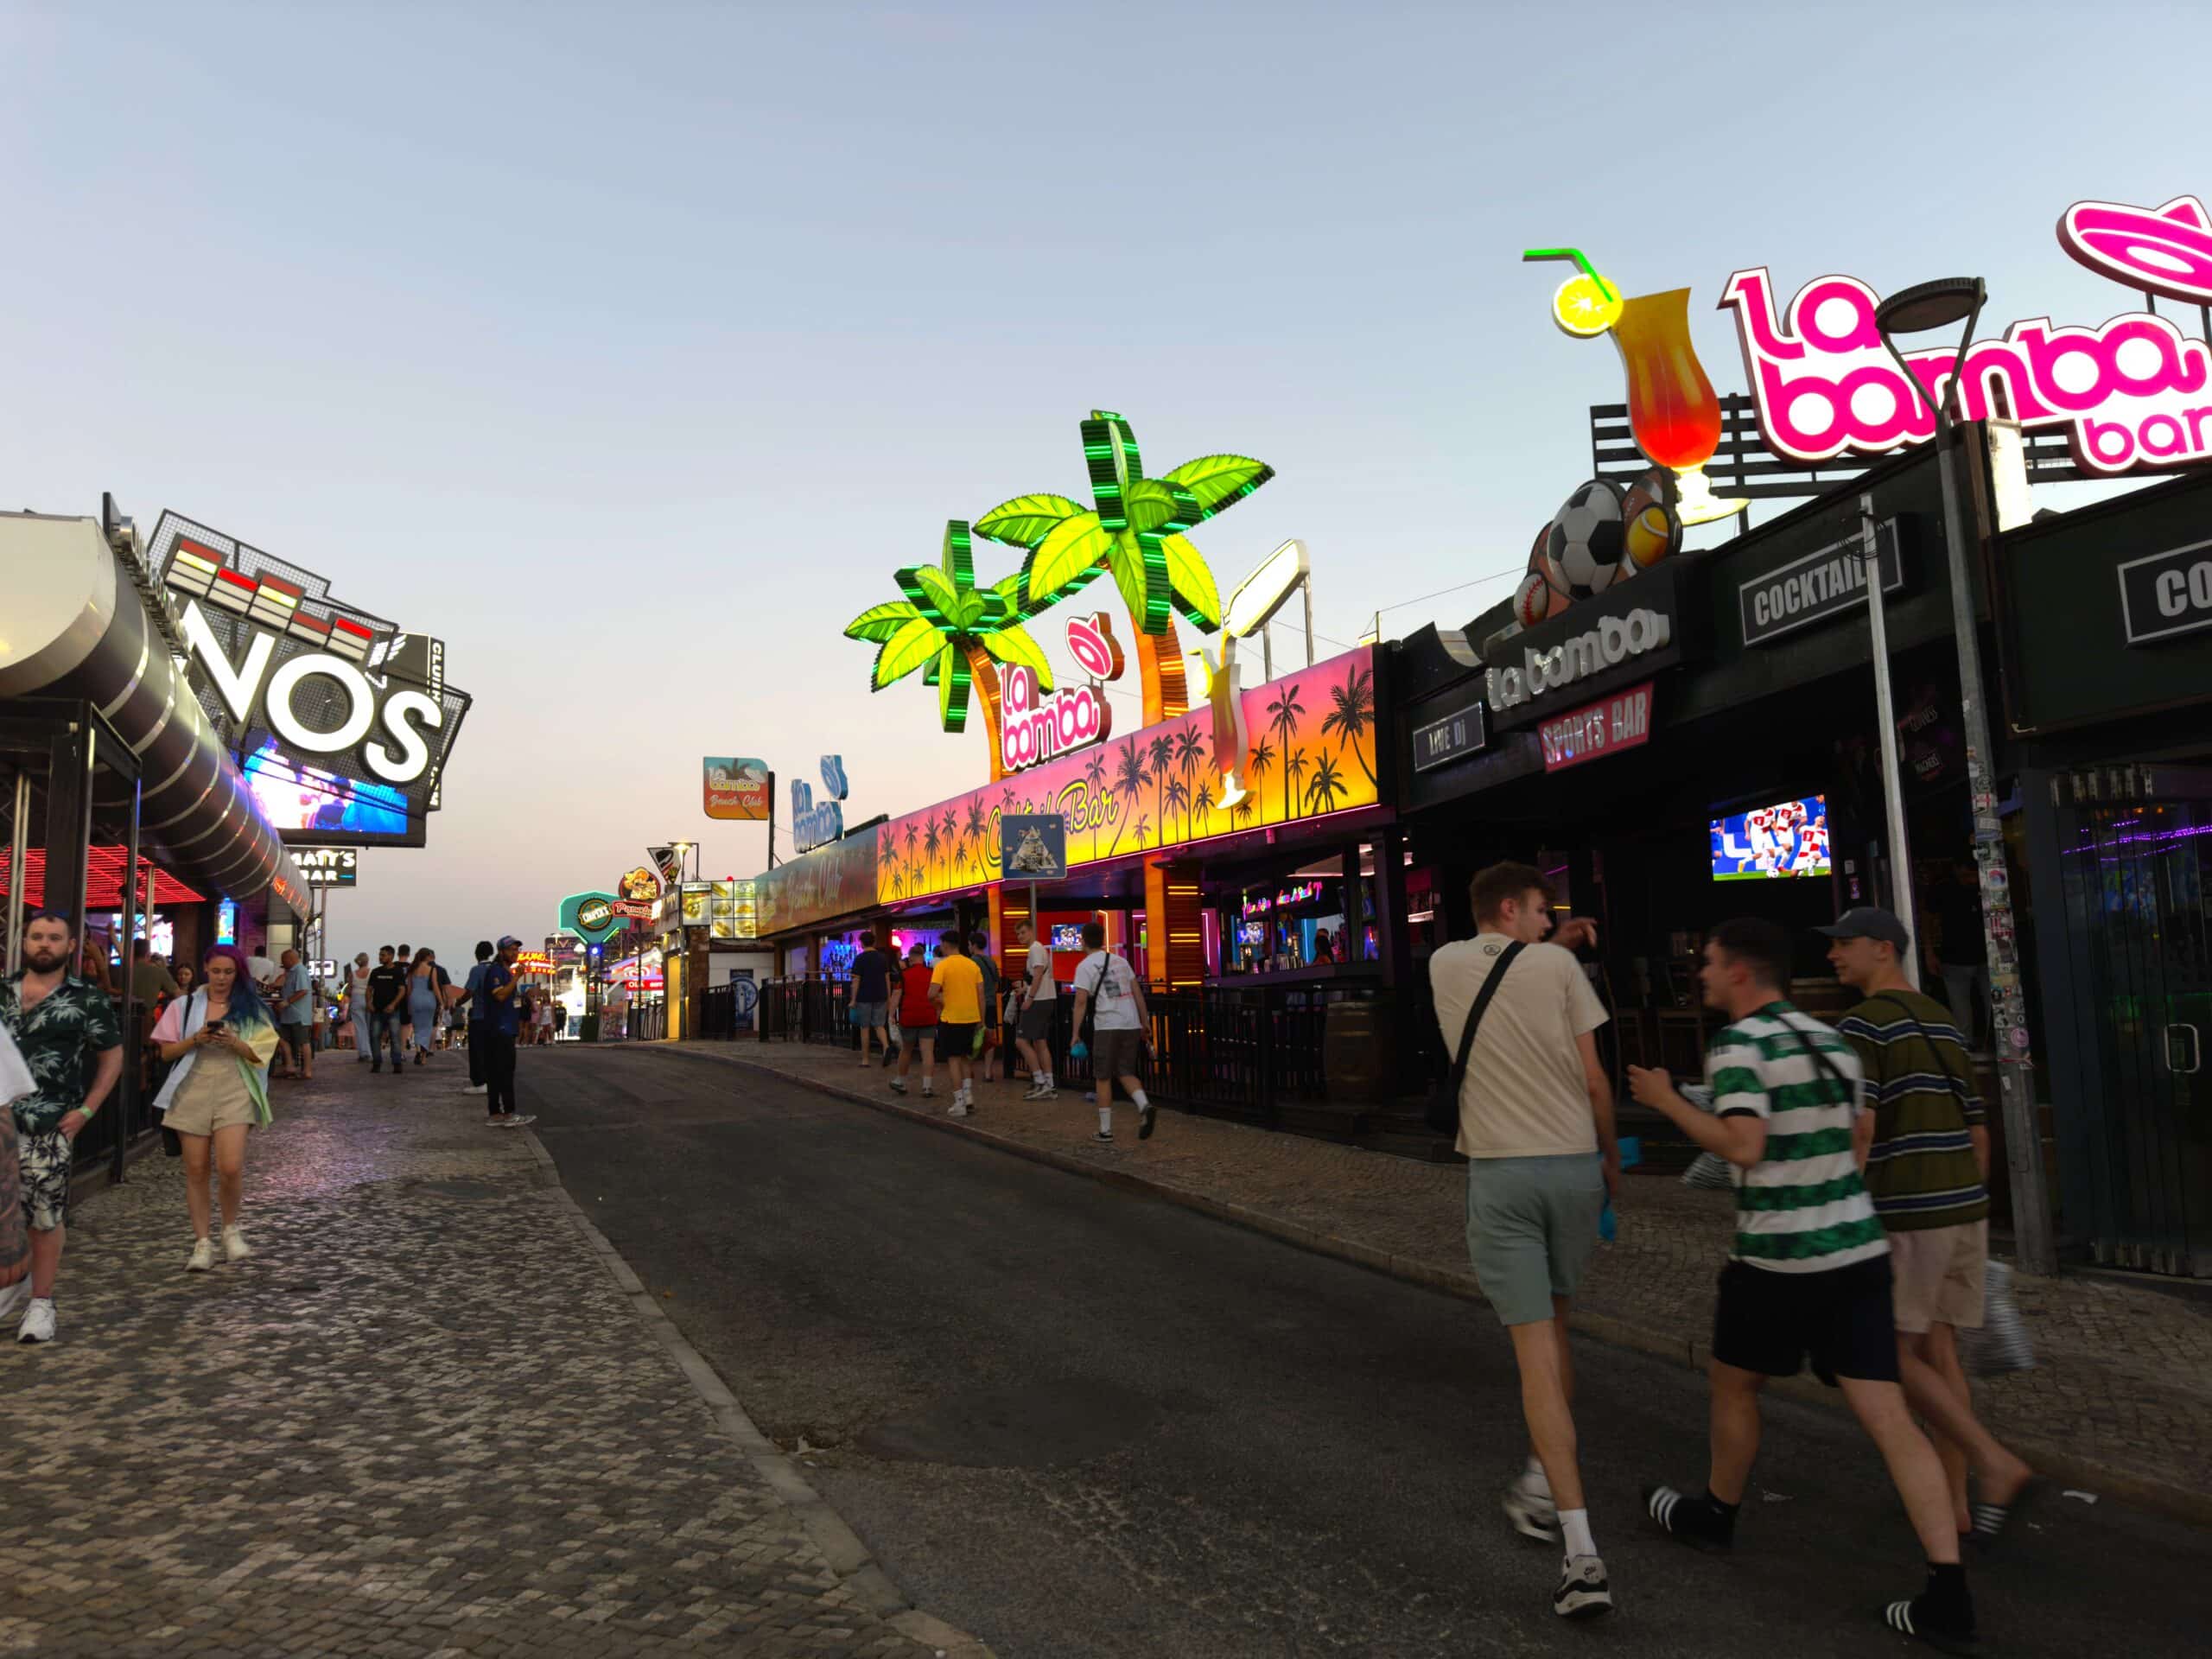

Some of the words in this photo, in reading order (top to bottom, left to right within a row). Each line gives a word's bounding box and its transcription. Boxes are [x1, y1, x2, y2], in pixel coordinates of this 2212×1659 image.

[1726, 270, 1884, 361] la
[1754, 316, 2210, 456] bamba
[2083, 404, 2212, 468] bar
[1524, 608, 1664, 695] bamba
[1001, 666, 1029, 715] la
[1002, 690, 1101, 769] bamba
[1542, 707, 1605, 764] SPORTS
[1611, 692, 1646, 744] BAR
[710, 779, 760, 791] bamba
[710, 795, 740, 808] Beach
[742, 794, 762, 808] Club
[1055, 779, 1119, 835] Bar
